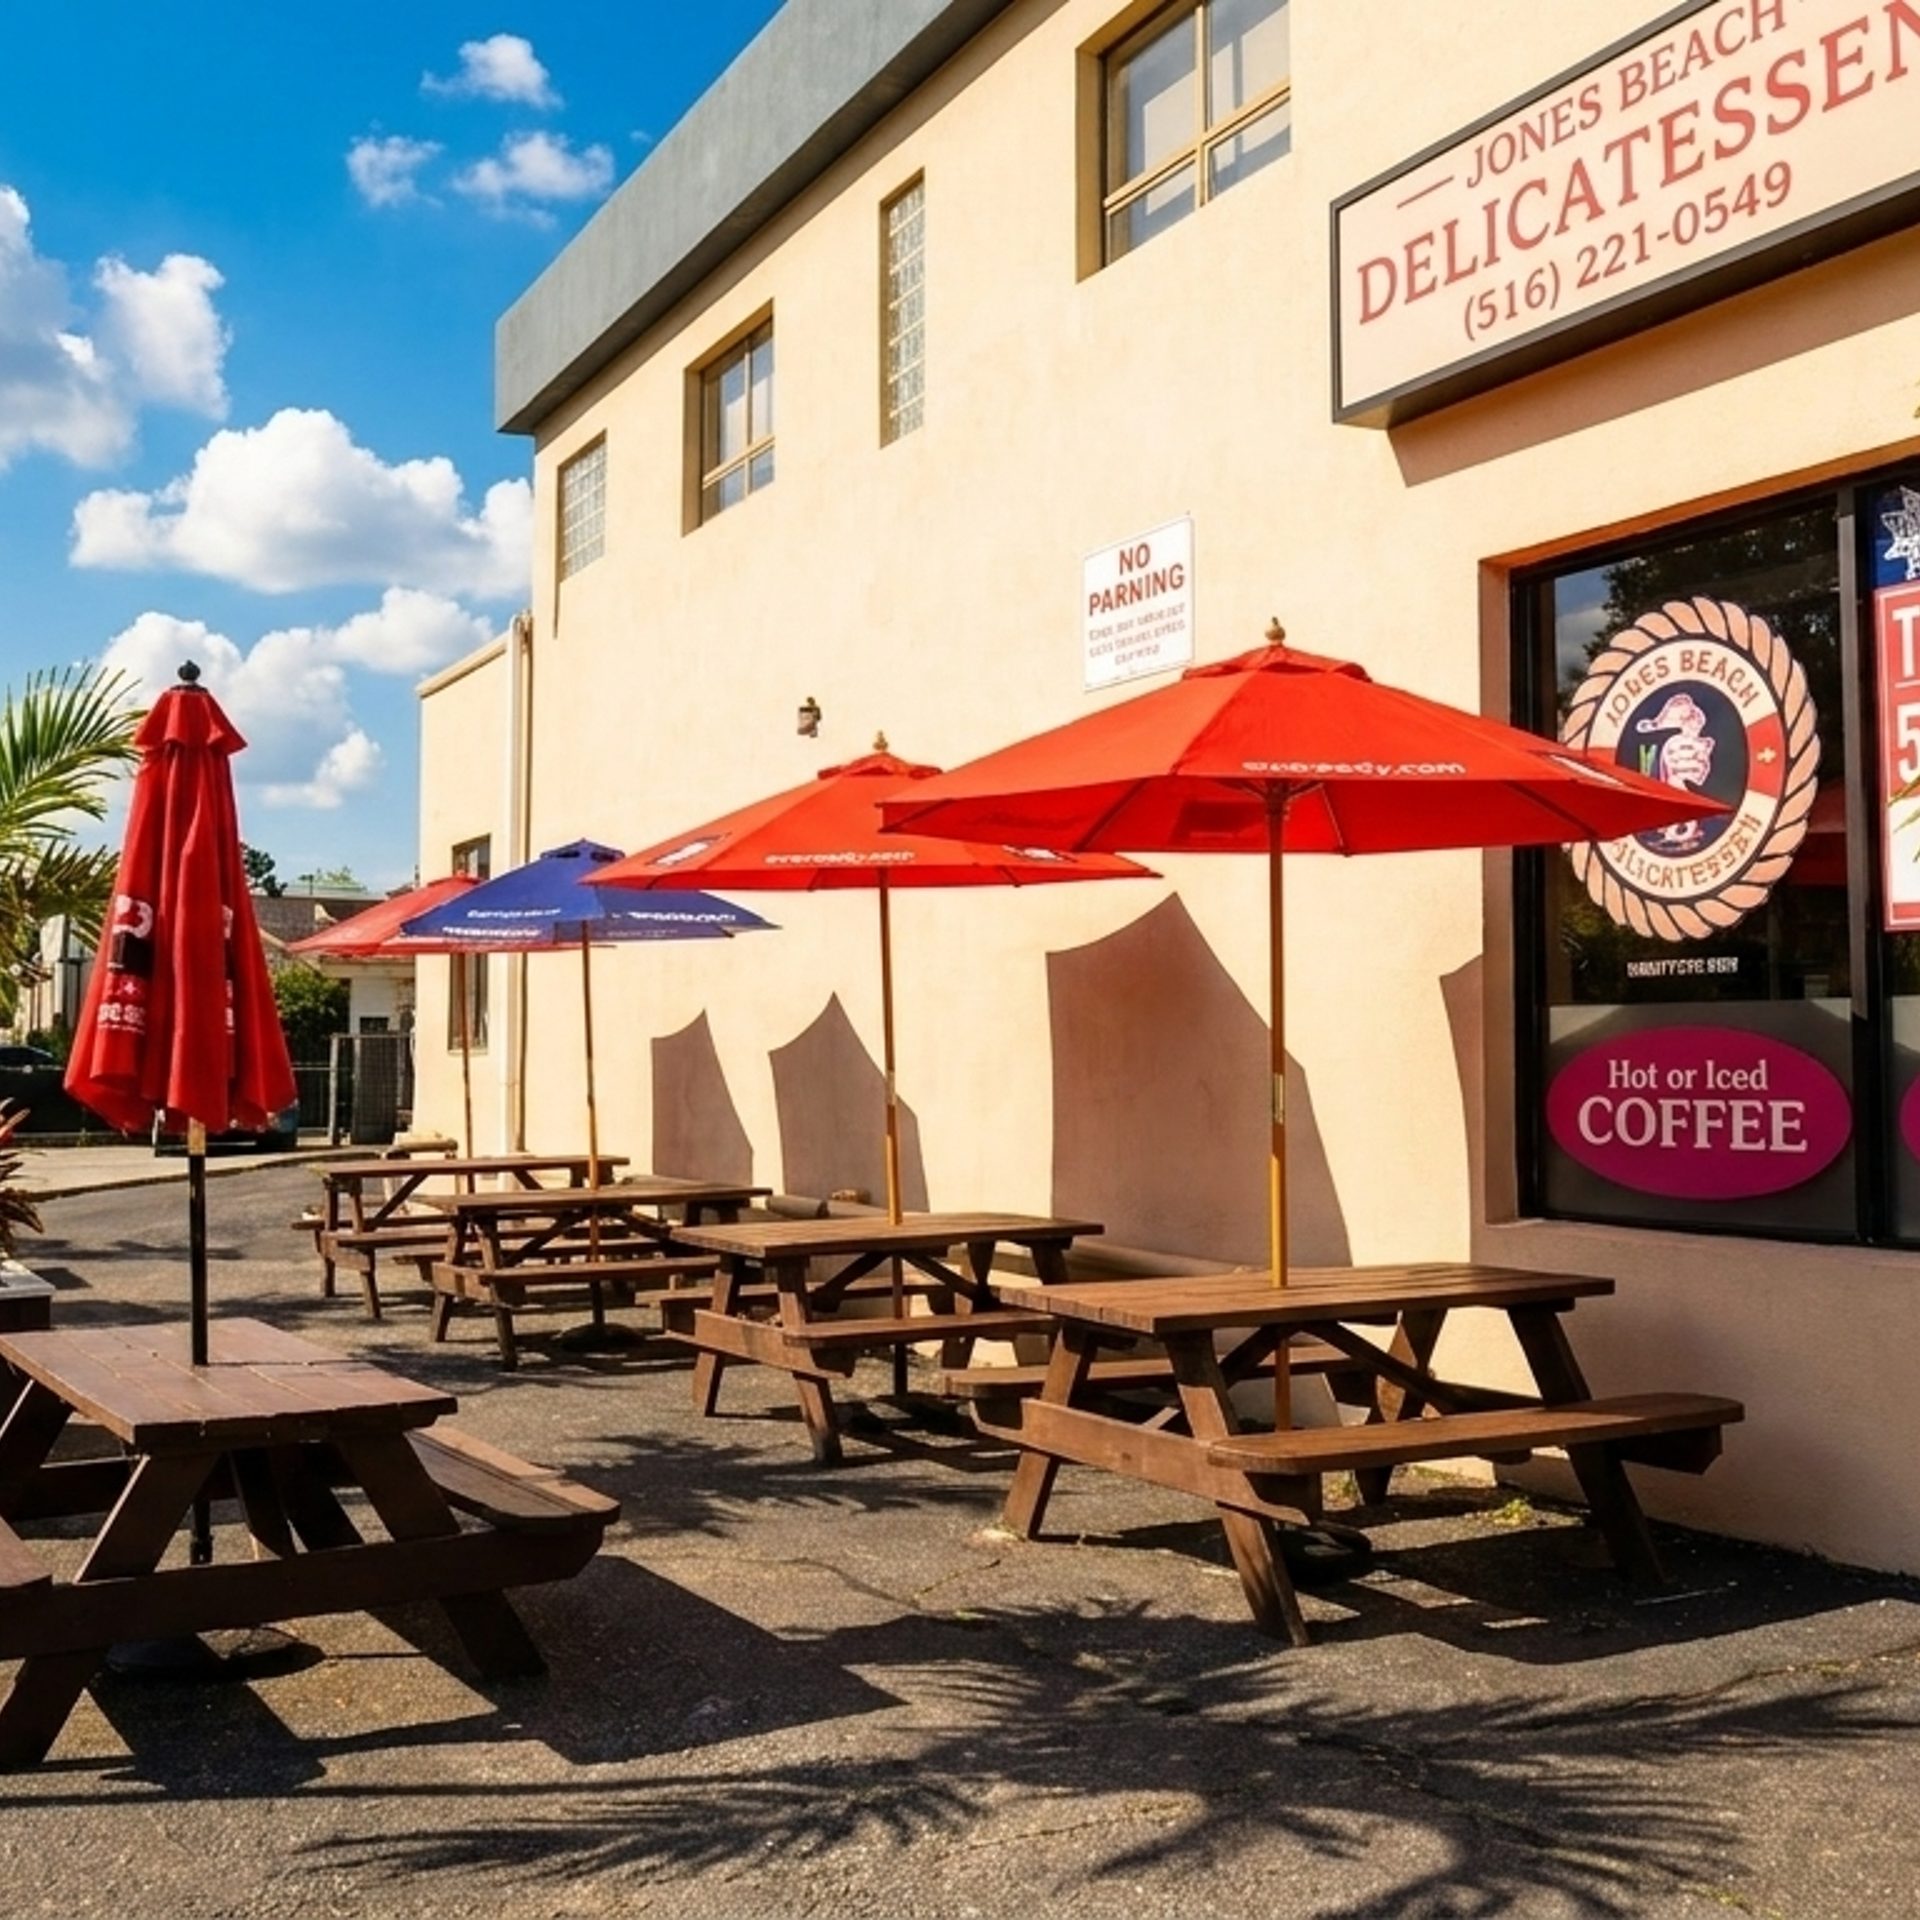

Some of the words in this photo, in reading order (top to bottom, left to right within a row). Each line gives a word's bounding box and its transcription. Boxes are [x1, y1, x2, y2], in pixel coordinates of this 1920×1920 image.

[1466, 85, 1602, 188] JONES
[1618, 0, 1787, 111] BEACH
[1464, 262, 1561, 341] (516)
[1576, 161, 1793, 288] 221-0549
[1119, 542, 1151, 576] NO
[1679, 649, 1761, 708] BEACH
[1607, 1059, 1658, 1090] Hot
[1666, 1069, 1698, 1091] or
[1705, 1058, 1769, 1091] Iced
[1577, 1095, 1808, 1153] COFFEE
